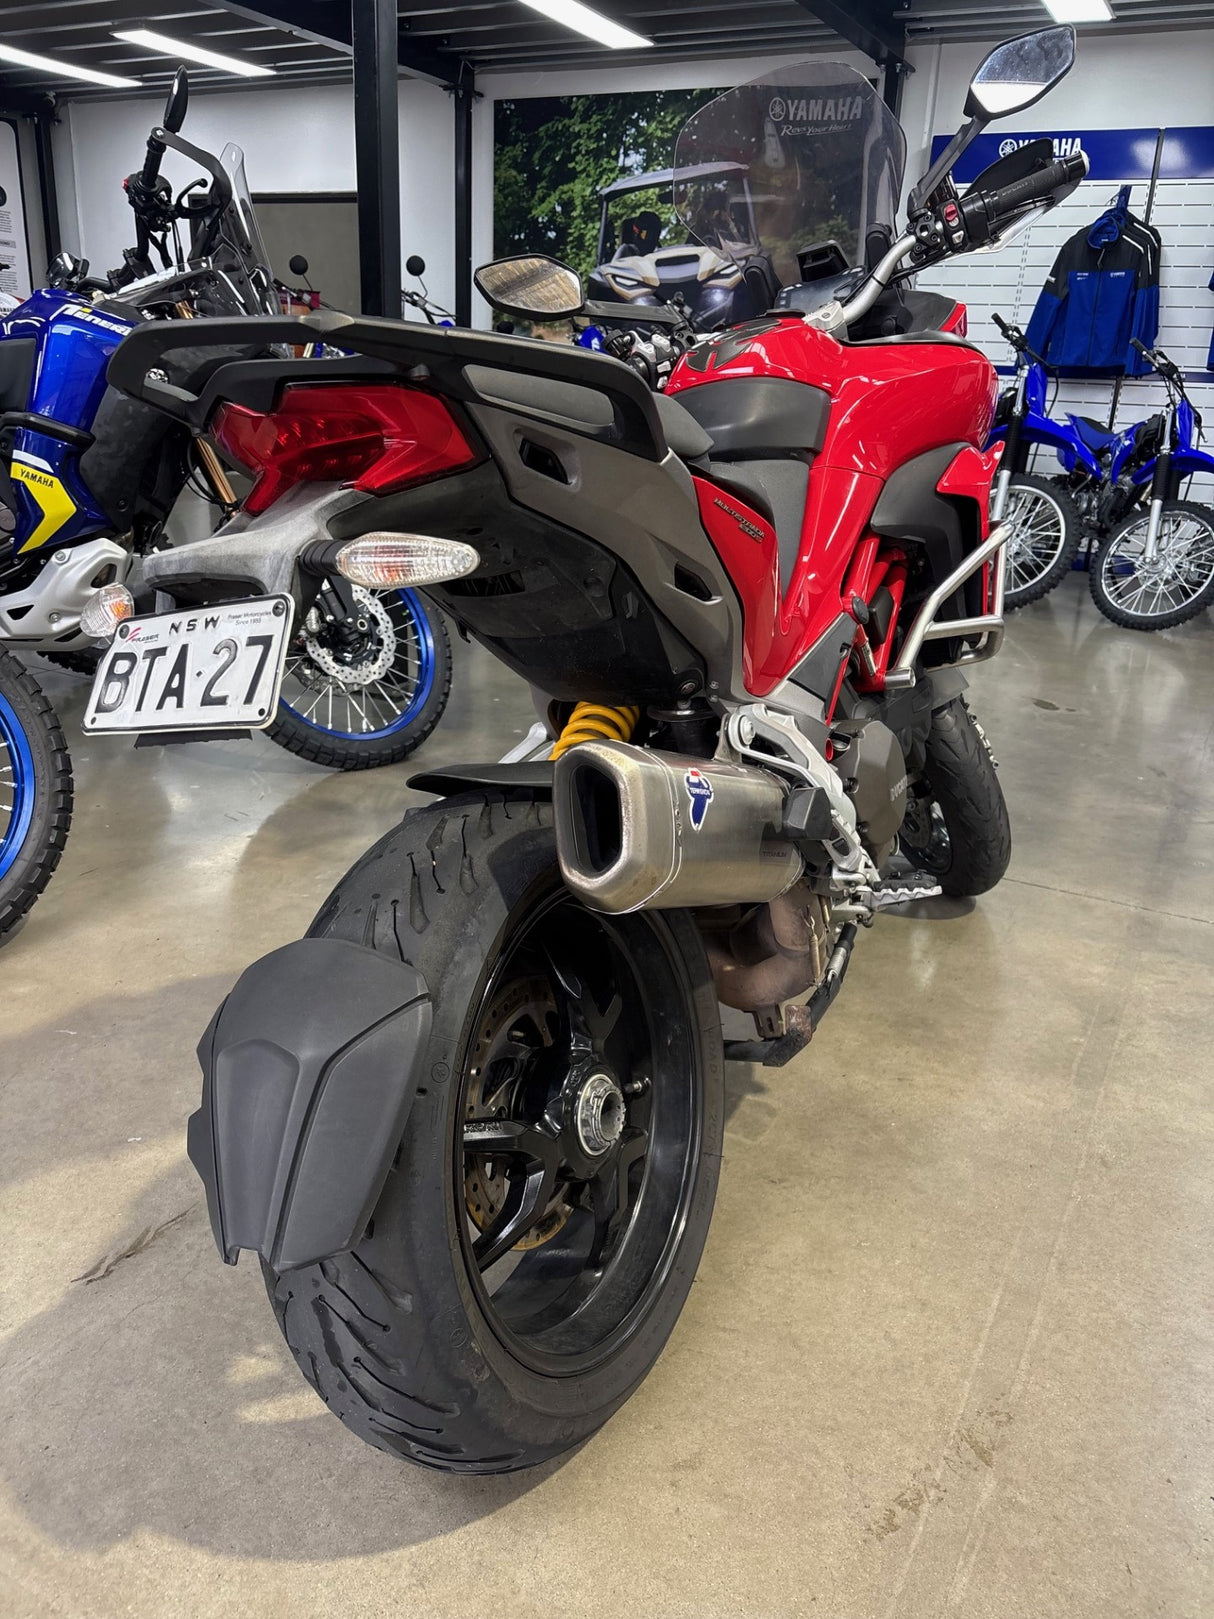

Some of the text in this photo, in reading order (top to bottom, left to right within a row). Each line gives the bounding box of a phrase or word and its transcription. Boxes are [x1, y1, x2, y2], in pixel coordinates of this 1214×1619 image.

[787, 96, 863, 121] YAMAHA
[20, 469, 54, 488] YAMAHA
[168, 615, 221, 635] NSW
